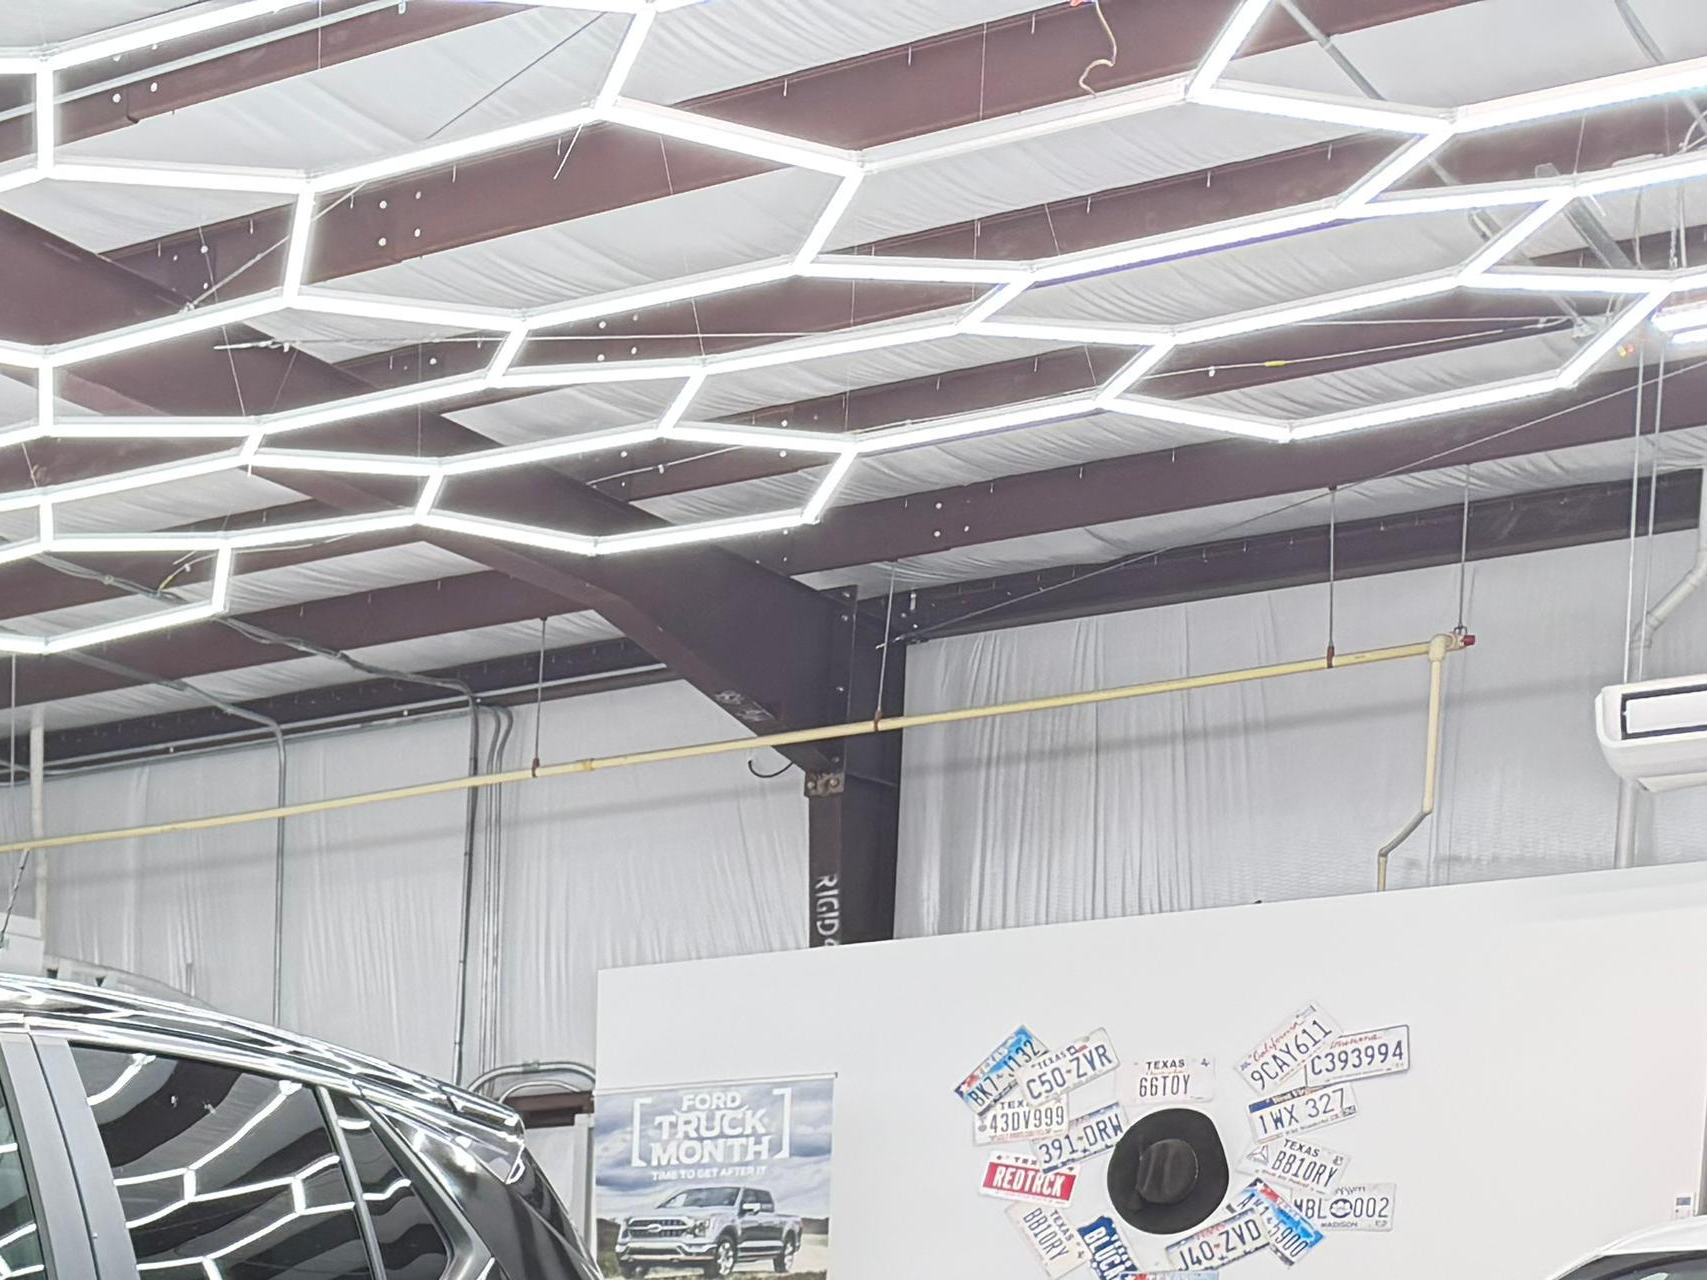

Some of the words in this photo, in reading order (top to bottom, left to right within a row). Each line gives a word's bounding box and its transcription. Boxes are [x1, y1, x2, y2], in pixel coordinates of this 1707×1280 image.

[814, 873, 840, 936] RIGID
[1146, 1059, 1186, 1071] TEXAS
[1250, 1019, 1333, 1091] 9CAY611
[1310, 1039, 1404, 1076] C393994
[682, 1091, 742, 1112] FORD
[1305, 1088, 1346, 1119] 327
[654, 1108, 768, 1140] TRUCK
[989, 1105, 1065, 1134] 43DV999
[650, 1135, 772, 1167] MONTH
[1283, 1138, 1321, 1158] TEXAS
[992, 1166, 1066, 1197] REDTRCK
[1049, 1209, 1075, 1243] TEXAS
